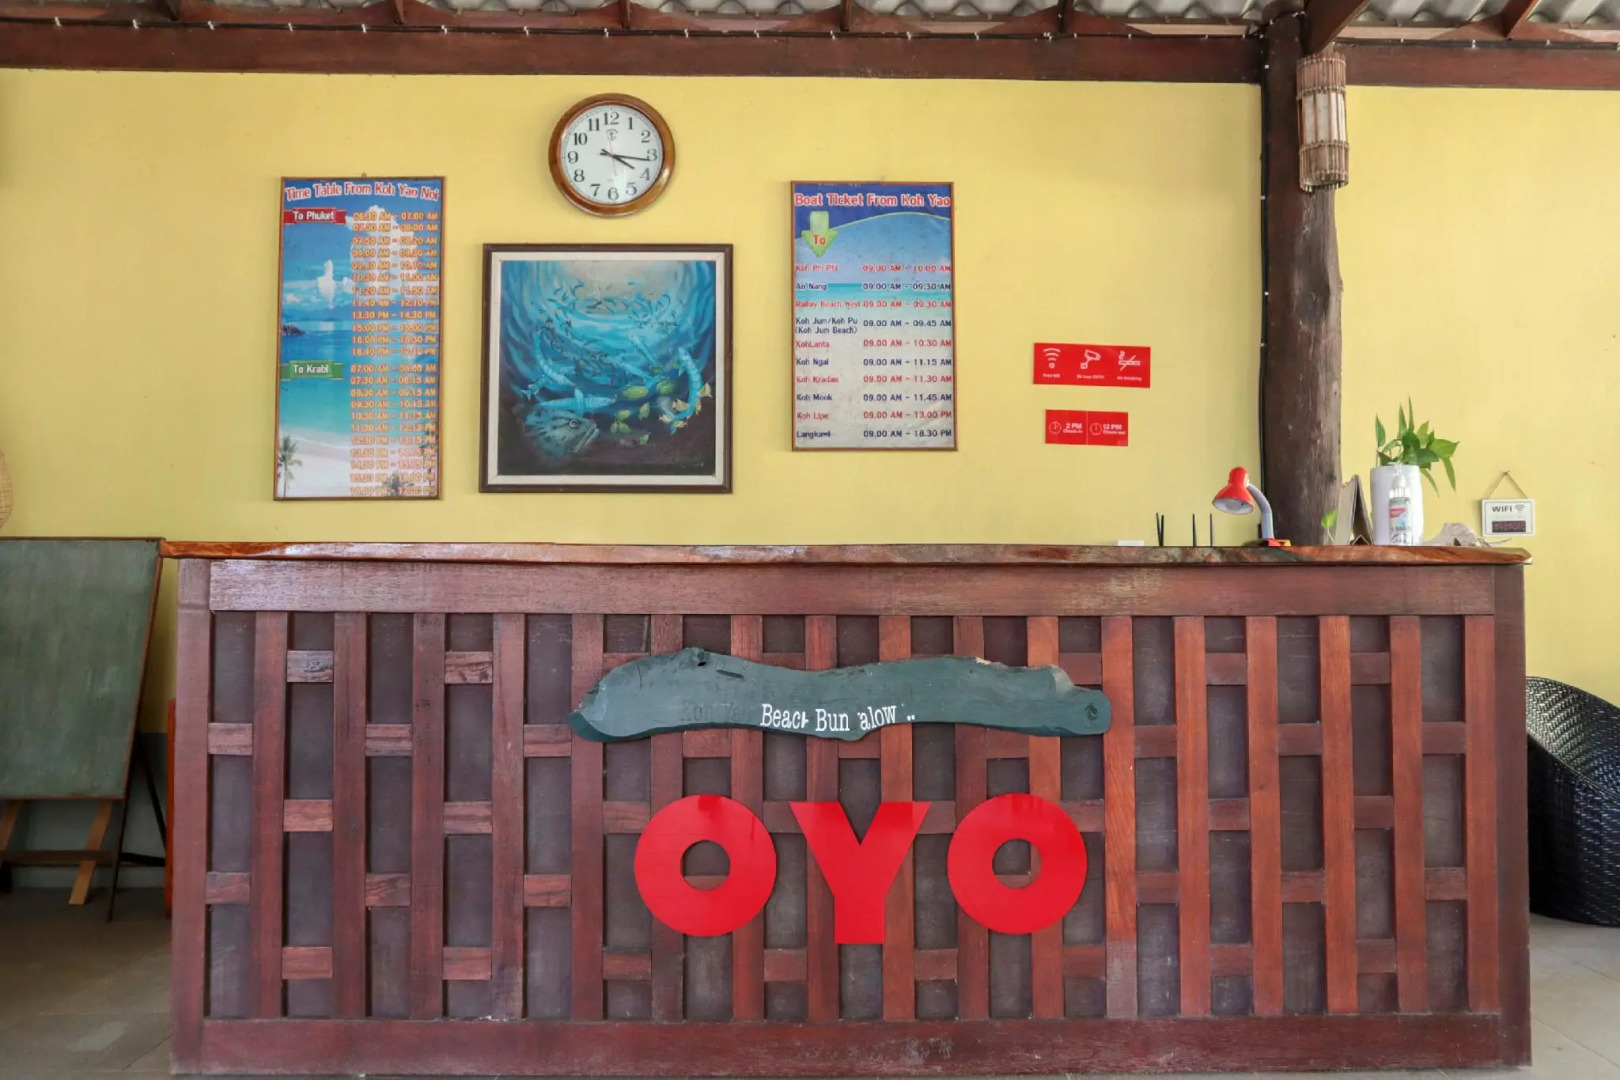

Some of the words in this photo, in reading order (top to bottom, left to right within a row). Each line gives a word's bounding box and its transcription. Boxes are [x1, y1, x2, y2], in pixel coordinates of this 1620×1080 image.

[588, 118, 600, 131] 11
[603, 112, 619, 125] 12
[628, 117, 633, 130] 1
[573, 133, 587, 145] 10
[641, 130, 651, 143] 2
[568, 151, 578, 164] 9
[647, 149, 657, 161] 3
[574, 169, 585, 182] 8
[639, 168, 650, 181] 4
[285, 187, 311, 201] Time
[314, 182, 342, 197] Table
[344, 182, 372, 195] From
[374, 182, 395, 195] Koh
[398, 184, 418, 198] Yao
[420, 188, 440, 201] Noi
[590, 184, 601, 197] 7
[608, 188, 619, 201] 6
[626, 182, 637, 195] 5
[795, 193, 823, 207] Boat
[828, 193, 863, 206] Ticket
[867, 194, 898, 206] From
[901, 194, 924, 206] Koh
[928, 194, 951, 206] Yao
[293, 211, 303, 220] To
[306, 211, 335, 220] Phuket
[813, 234, 826, 246] To
[796, 317, 811, 325] Koh
[832, 326, 858, 334] Beach)
[863, 358, 887, 366] 09.00
[890, 358, 902, 366] AM
[913, 358, 938, 366] 11.15
[940, 358, 952, 366] AM
[293, 365, 304, 373] To
[863, 375, 887, 383] 09.00
[890, 375, 902, 383] AM
[913, 375, 938, 383] 11.30
[940, 375, 952, 383] AM
[863, 393, 887, 401] 09.00
[890, 393, 902, 401] AM
[913, 393, 938, 401] 11.45
[940, 393, 952, 401] AM
[633, 792, 1088, 945] OYO
